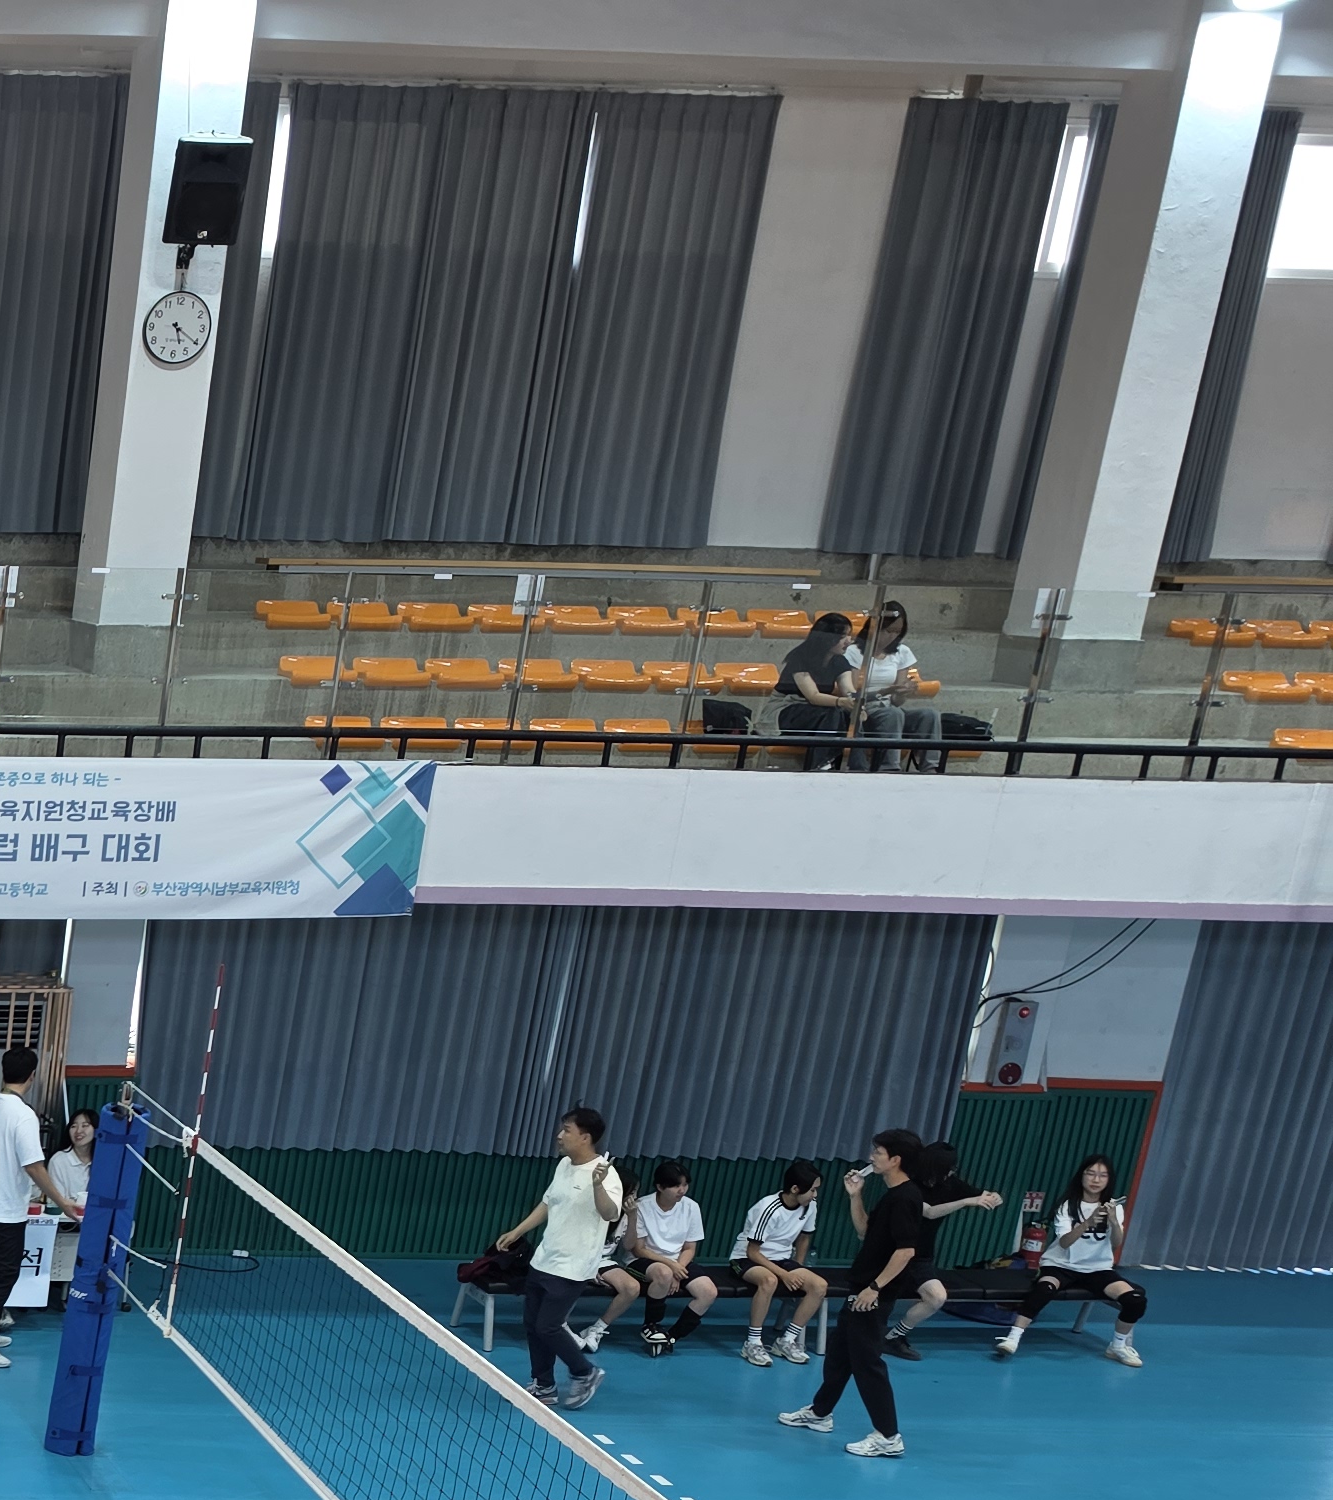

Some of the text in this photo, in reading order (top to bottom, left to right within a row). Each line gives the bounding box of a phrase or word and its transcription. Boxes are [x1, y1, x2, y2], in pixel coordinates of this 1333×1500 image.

[164, 300, 172, 309] 11
[176, 296, 186, 306] 12
[191, 300, 195, 309] 1
[154, 309, 164, 319] 10
[197, 309, 204, 319] 2
[148, 322, 155, 332] 9
[199, 324, 206, 333] 3
[150, 335, 158, 345] 8
[159, 346, 166, 355] 7
[169, 349, 177, 359] 6
[182, 346, 189, 356] 5
[50, 771, 79, 788] 하나
[82, 772, 110, 788] 되는
[30, 832, 91, 864] 배구
[100, 831, 162, 864] 대회
[91, 879, 301, 897] 주최 부산광역시남부교육지원청
